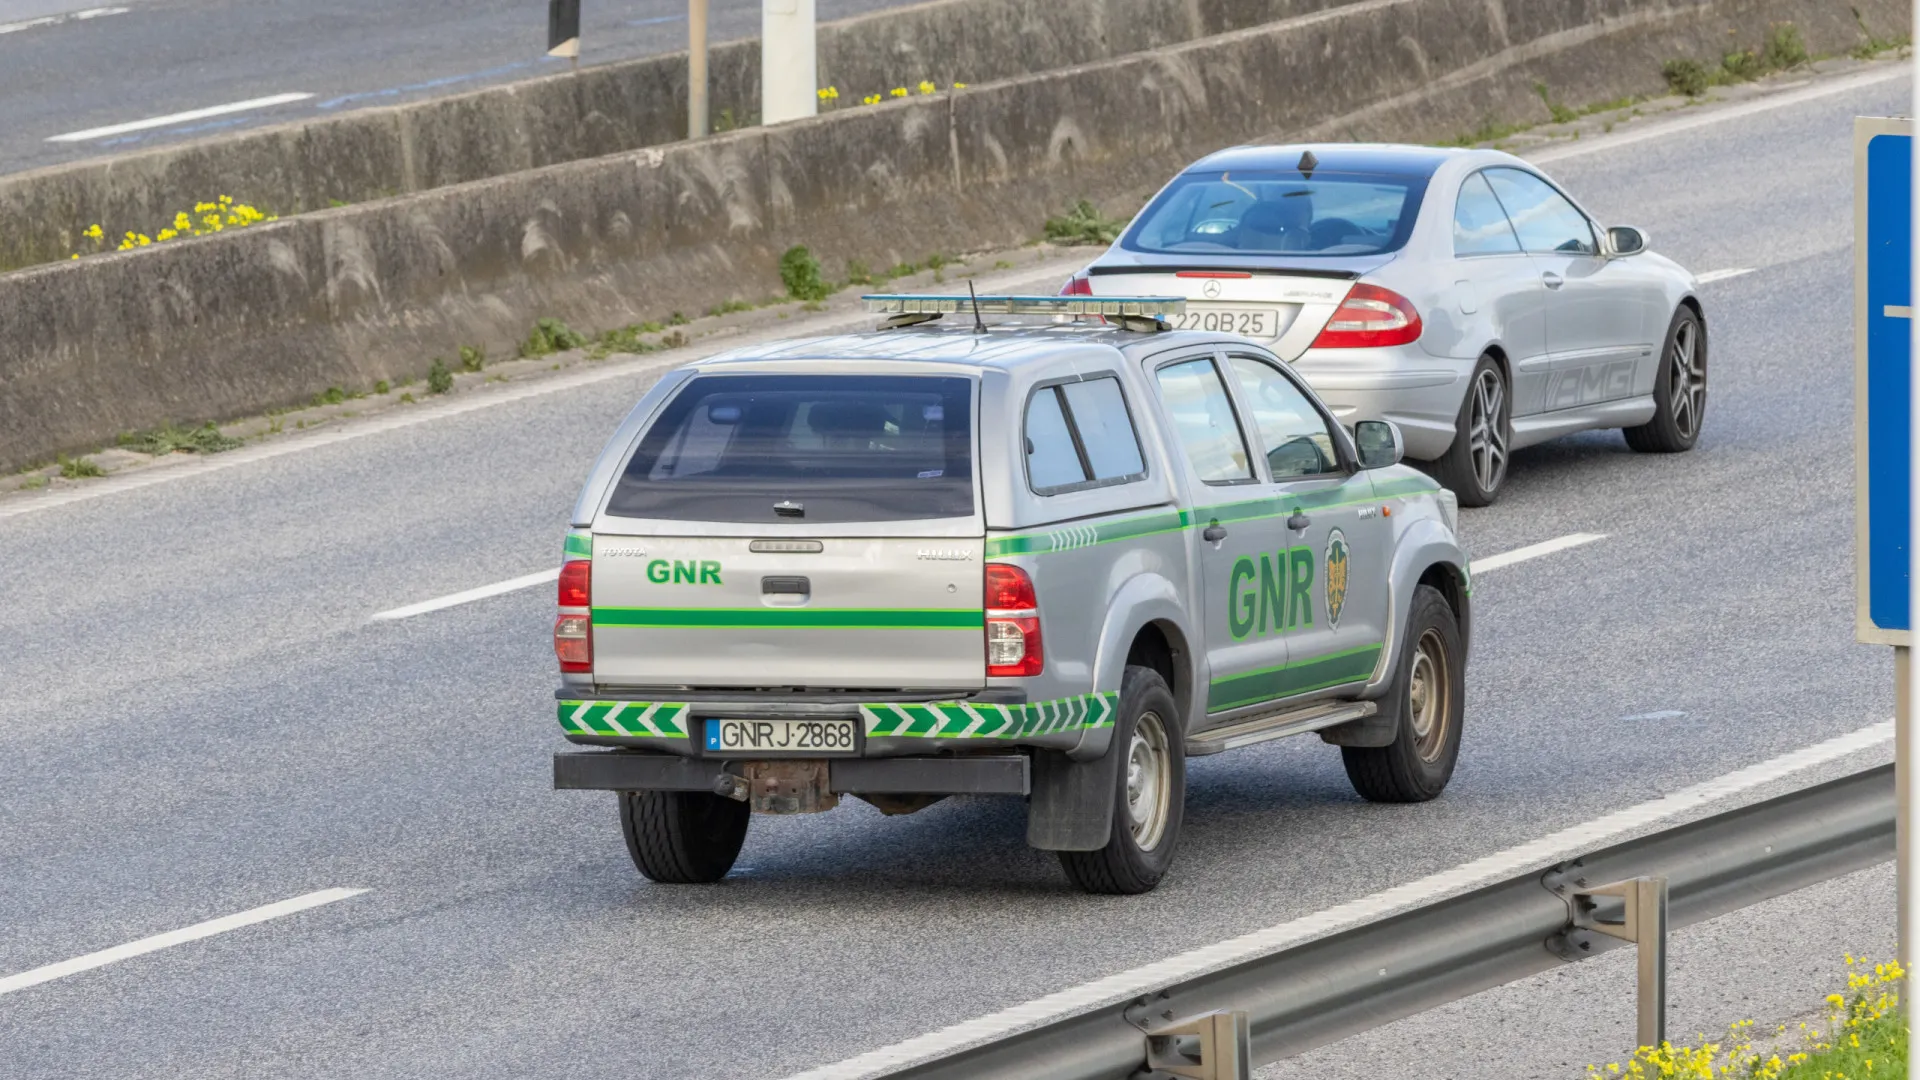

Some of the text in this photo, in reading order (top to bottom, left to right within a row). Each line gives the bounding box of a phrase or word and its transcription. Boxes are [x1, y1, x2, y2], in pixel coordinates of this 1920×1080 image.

[602, 547, 647, 557] TOYOTA
[917, 549, 973, 561] HILUX
[645, 558, 724, 585] GNR
[1228, 545, 1315, 642] GNR
